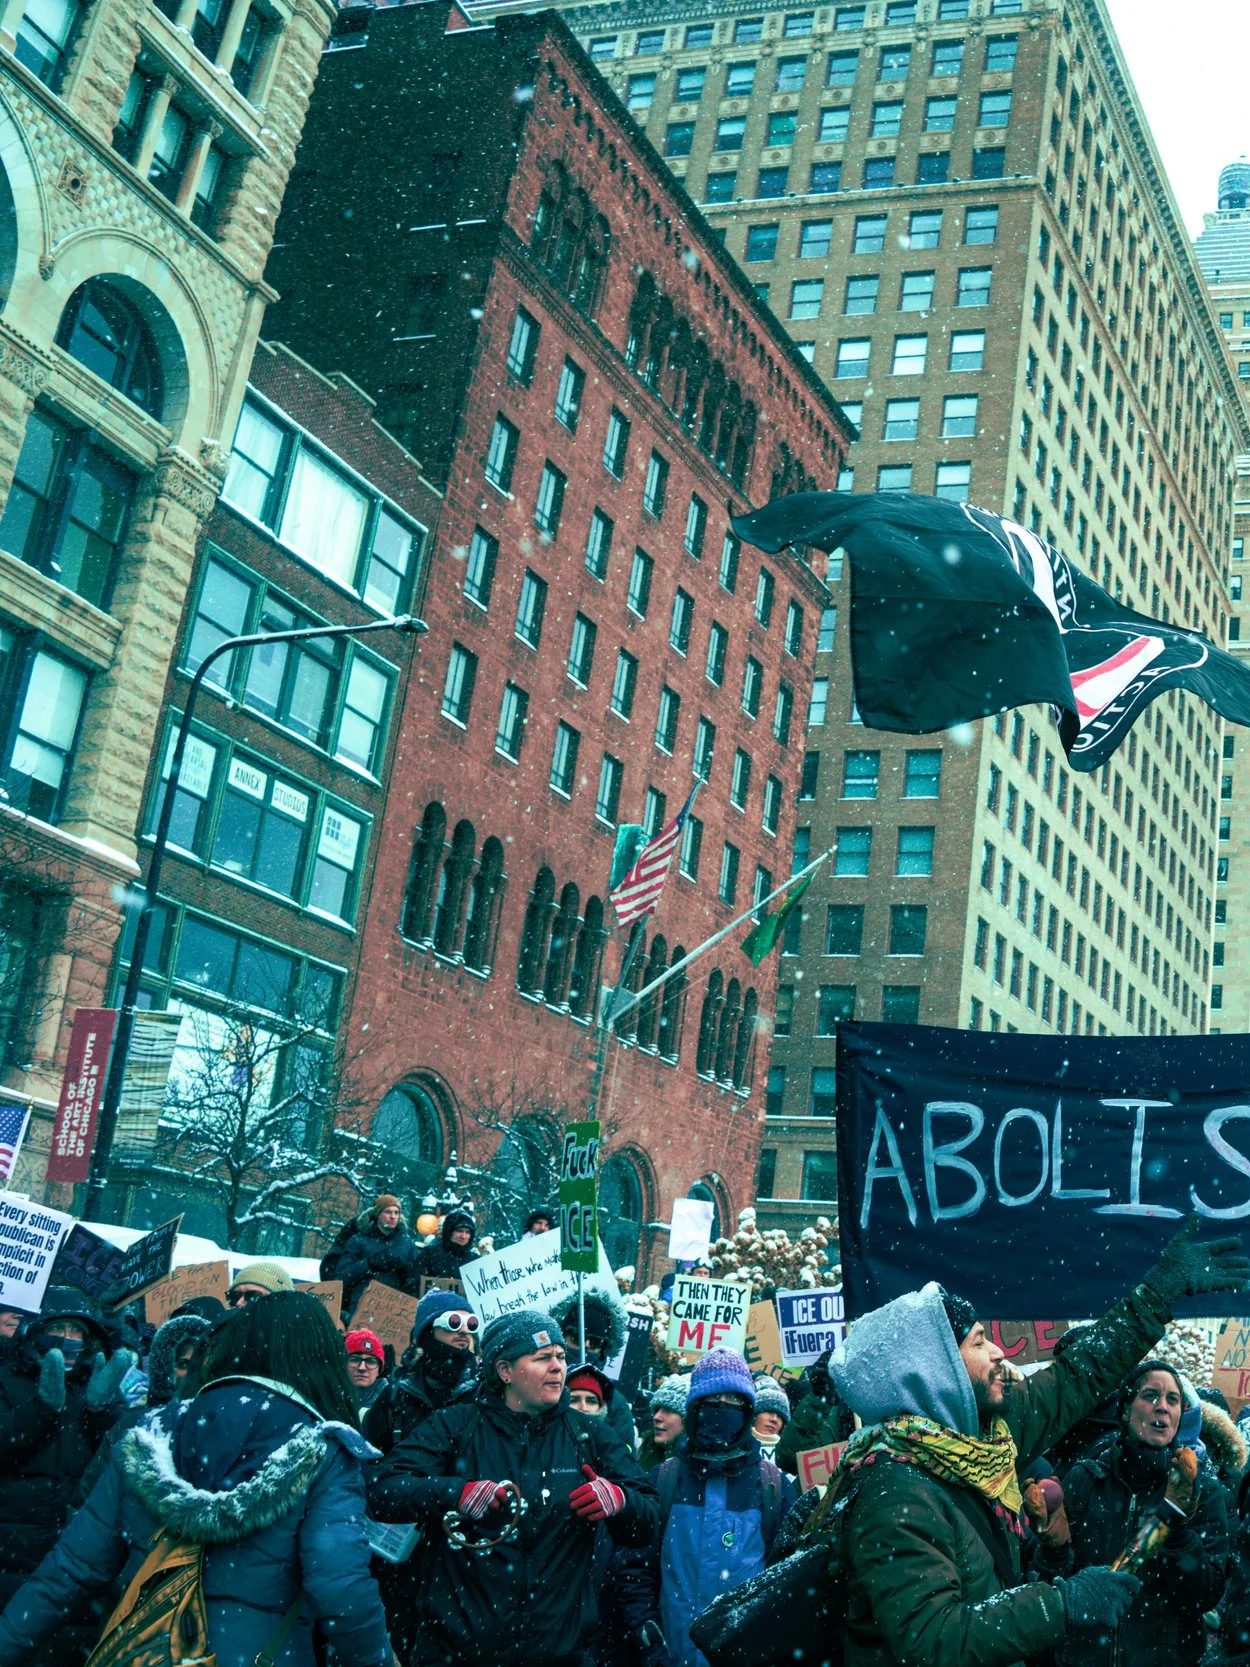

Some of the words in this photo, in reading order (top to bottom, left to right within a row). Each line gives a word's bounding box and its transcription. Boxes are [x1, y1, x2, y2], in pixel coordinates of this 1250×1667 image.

[234, 767, 262, 792] ANNEX
[273, 787, 308, 816] STUDIOS
[76, 1032, 97, 1099] INSTITUTE
[57, 1104, 74, 1157] SCHOOL
[67, 1082, 77, 1101] OF
[72, 1102, 83, 1127] ART
[79, 1078, 97, 1136] CHICAGO
[66, 1130, 78, 1157] THE
[76, 1140, 86, 1158] OF
[0, 1223, 44, 1248] publican
[44, 1235, 56, 1251] is
[29, 1212, 62, 1236] sitting
[560, 1201, 595, 1253] ICE
[0, 1243, 35, 1265] mplicit
[34, 1251, 46, 1268] in
[0, 1261, 24, 1280] ction
[25, 1270, 39, 1284] of
[466, 1267, 503, 1297] When
[499, 1261, 526, 1286] those
[525, 1257, 543, 1276] who
[480, 1304, 495, 1323] law
[526, 1289, 539, 1301] the
[541, 1282, 557, 1297] law
[559, 1279, 568, 1288] in
[678, 1281, 709, 1300] THEN
[712, 1284, 747, 1304] THEY
[629, 1316, 650, 1331] SH
[673, 1301, 711, 1321] CAME
[714, 1305, 743, 1326] FOR
[792, 1298, 817, 1324] ICE
[820, 1296, 845, 1321] OU
[678, 1320, 731, 1351] ME
[990, 1320, 1060, 1357] CE
[803, 1444, 848, 1485] FU
